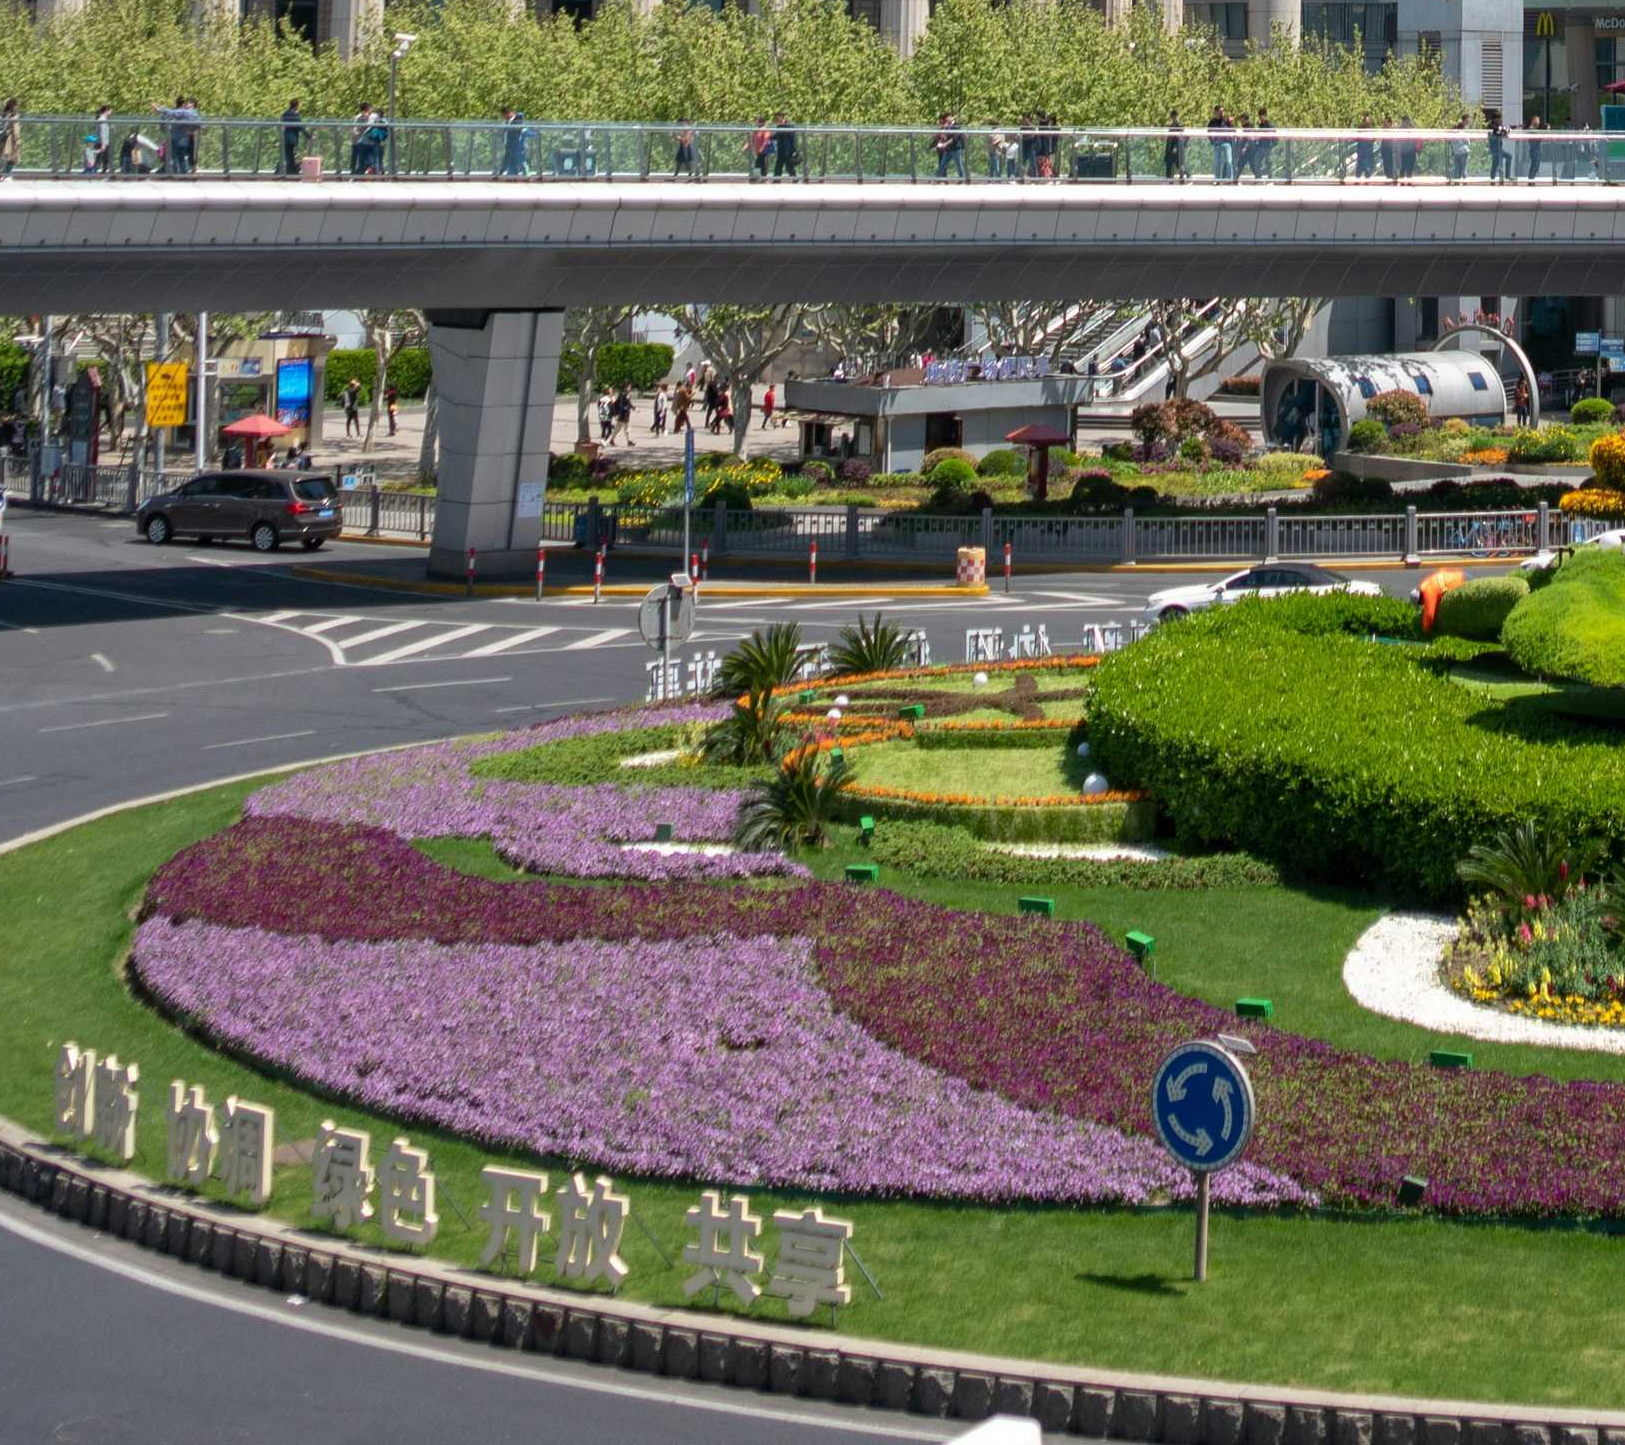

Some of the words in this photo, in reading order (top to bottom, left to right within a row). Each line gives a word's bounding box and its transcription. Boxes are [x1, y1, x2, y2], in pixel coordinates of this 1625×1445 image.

[52, 1040, 142, 1161] 创新
[165, 1077, 277, 1206] 协调
[310, 1118, 441, 1245] 绿色
[478, 1163, 631, 1286] 开放
[681, 1190, 855, 1319] 共享
